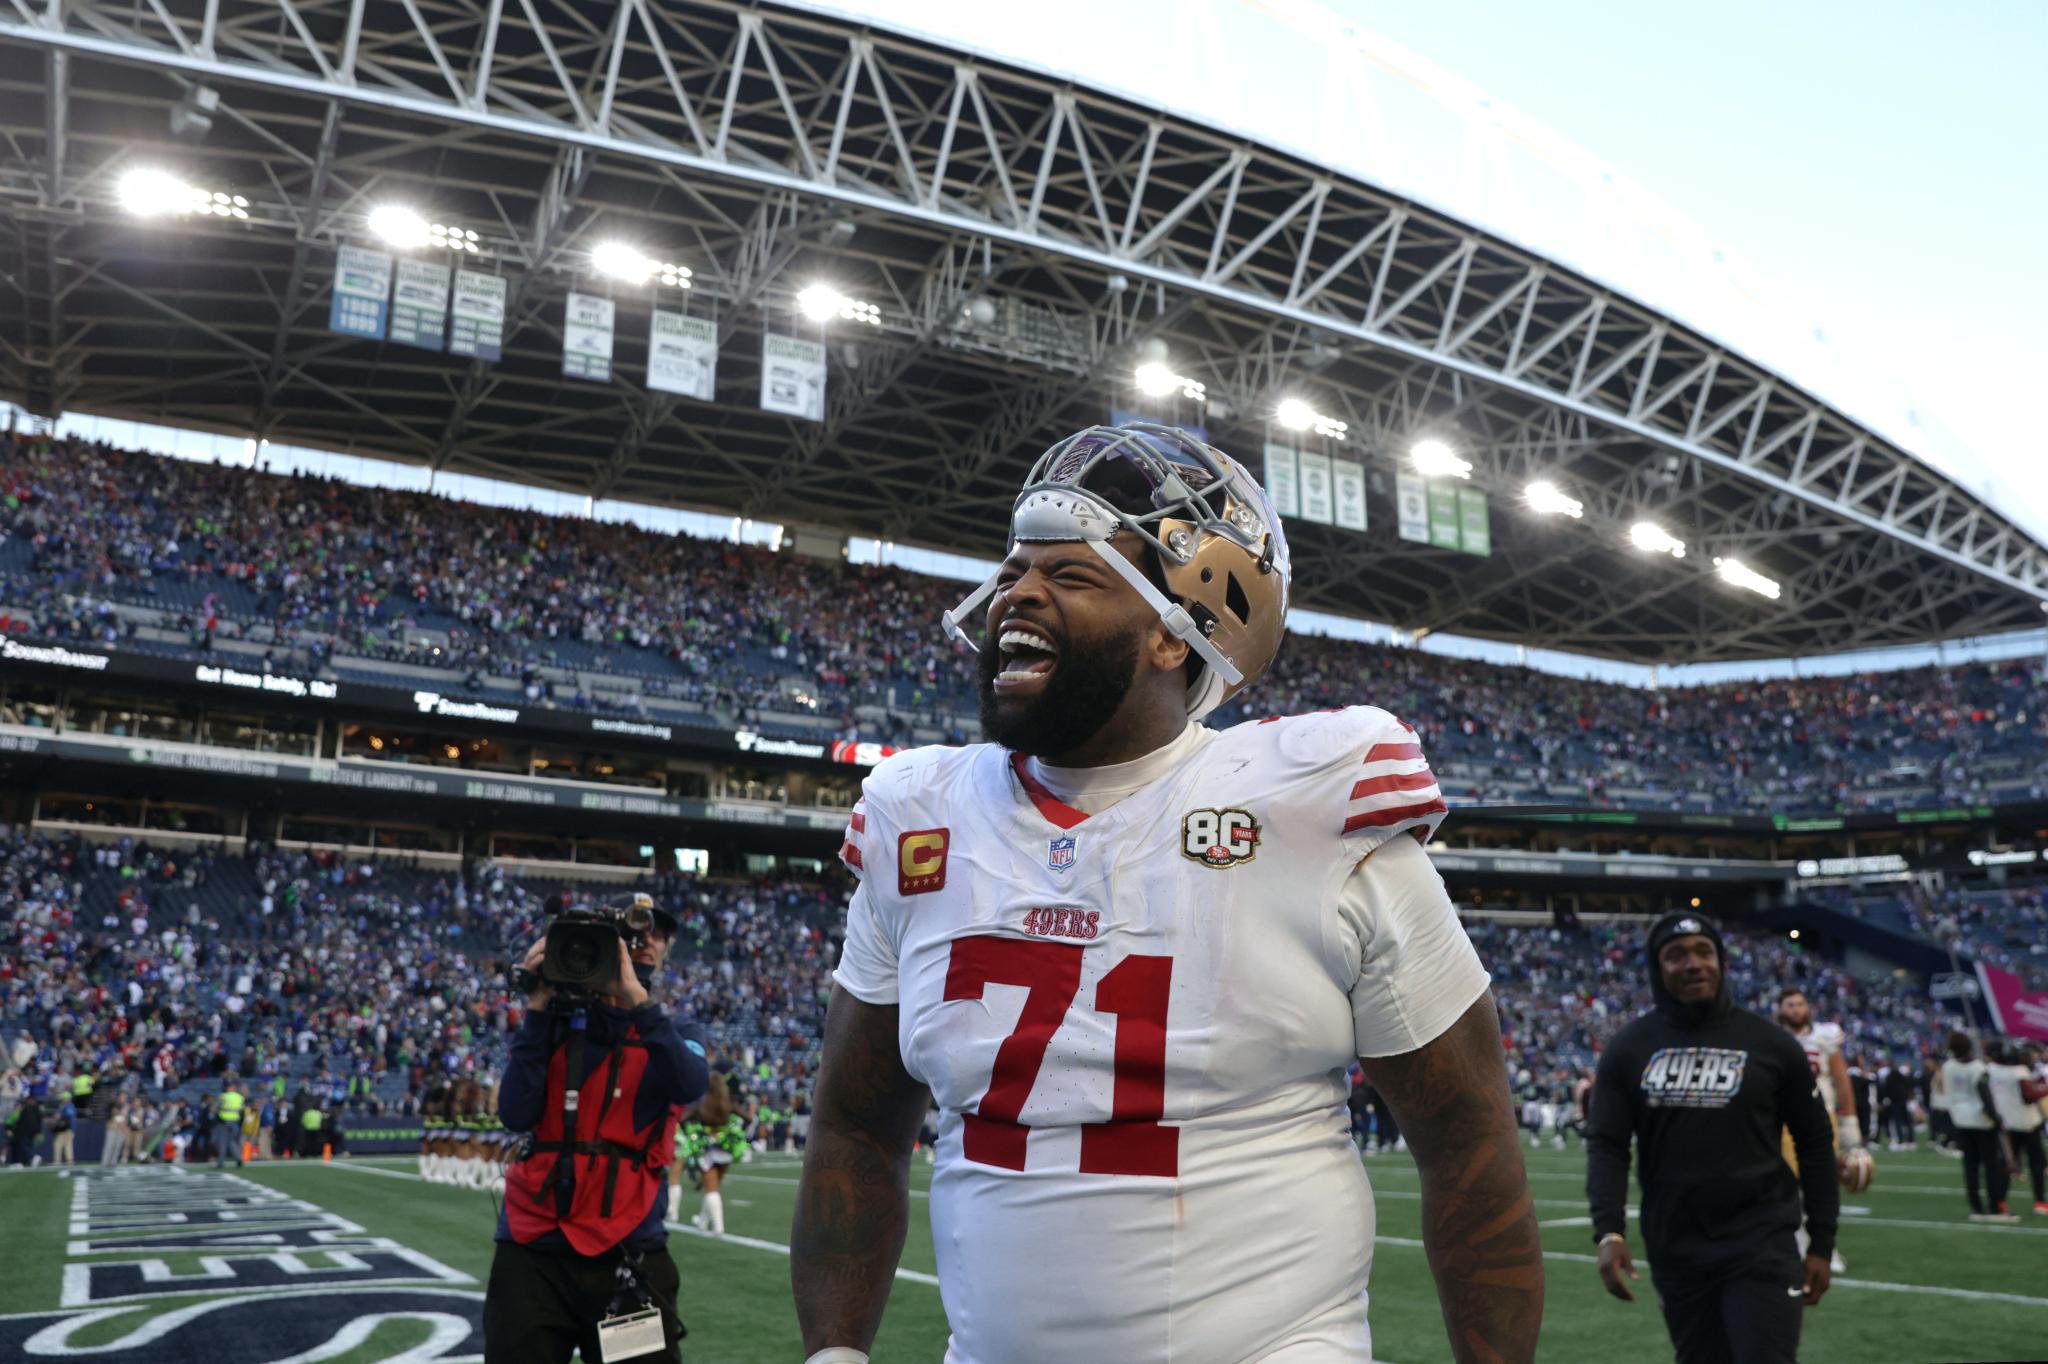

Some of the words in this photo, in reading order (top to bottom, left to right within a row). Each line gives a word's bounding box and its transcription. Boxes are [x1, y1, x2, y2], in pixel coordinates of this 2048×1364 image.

[1187, 811, 1252, 857] 80
[901, 833, 944, 877] C
[1051, 849, 1073, 865] NFL
[1022, 907, 1100, 940] 49ERS
[943, 935, 1180, 1178] 71
[1647, 1053, 1740, 1091] 49ERS
